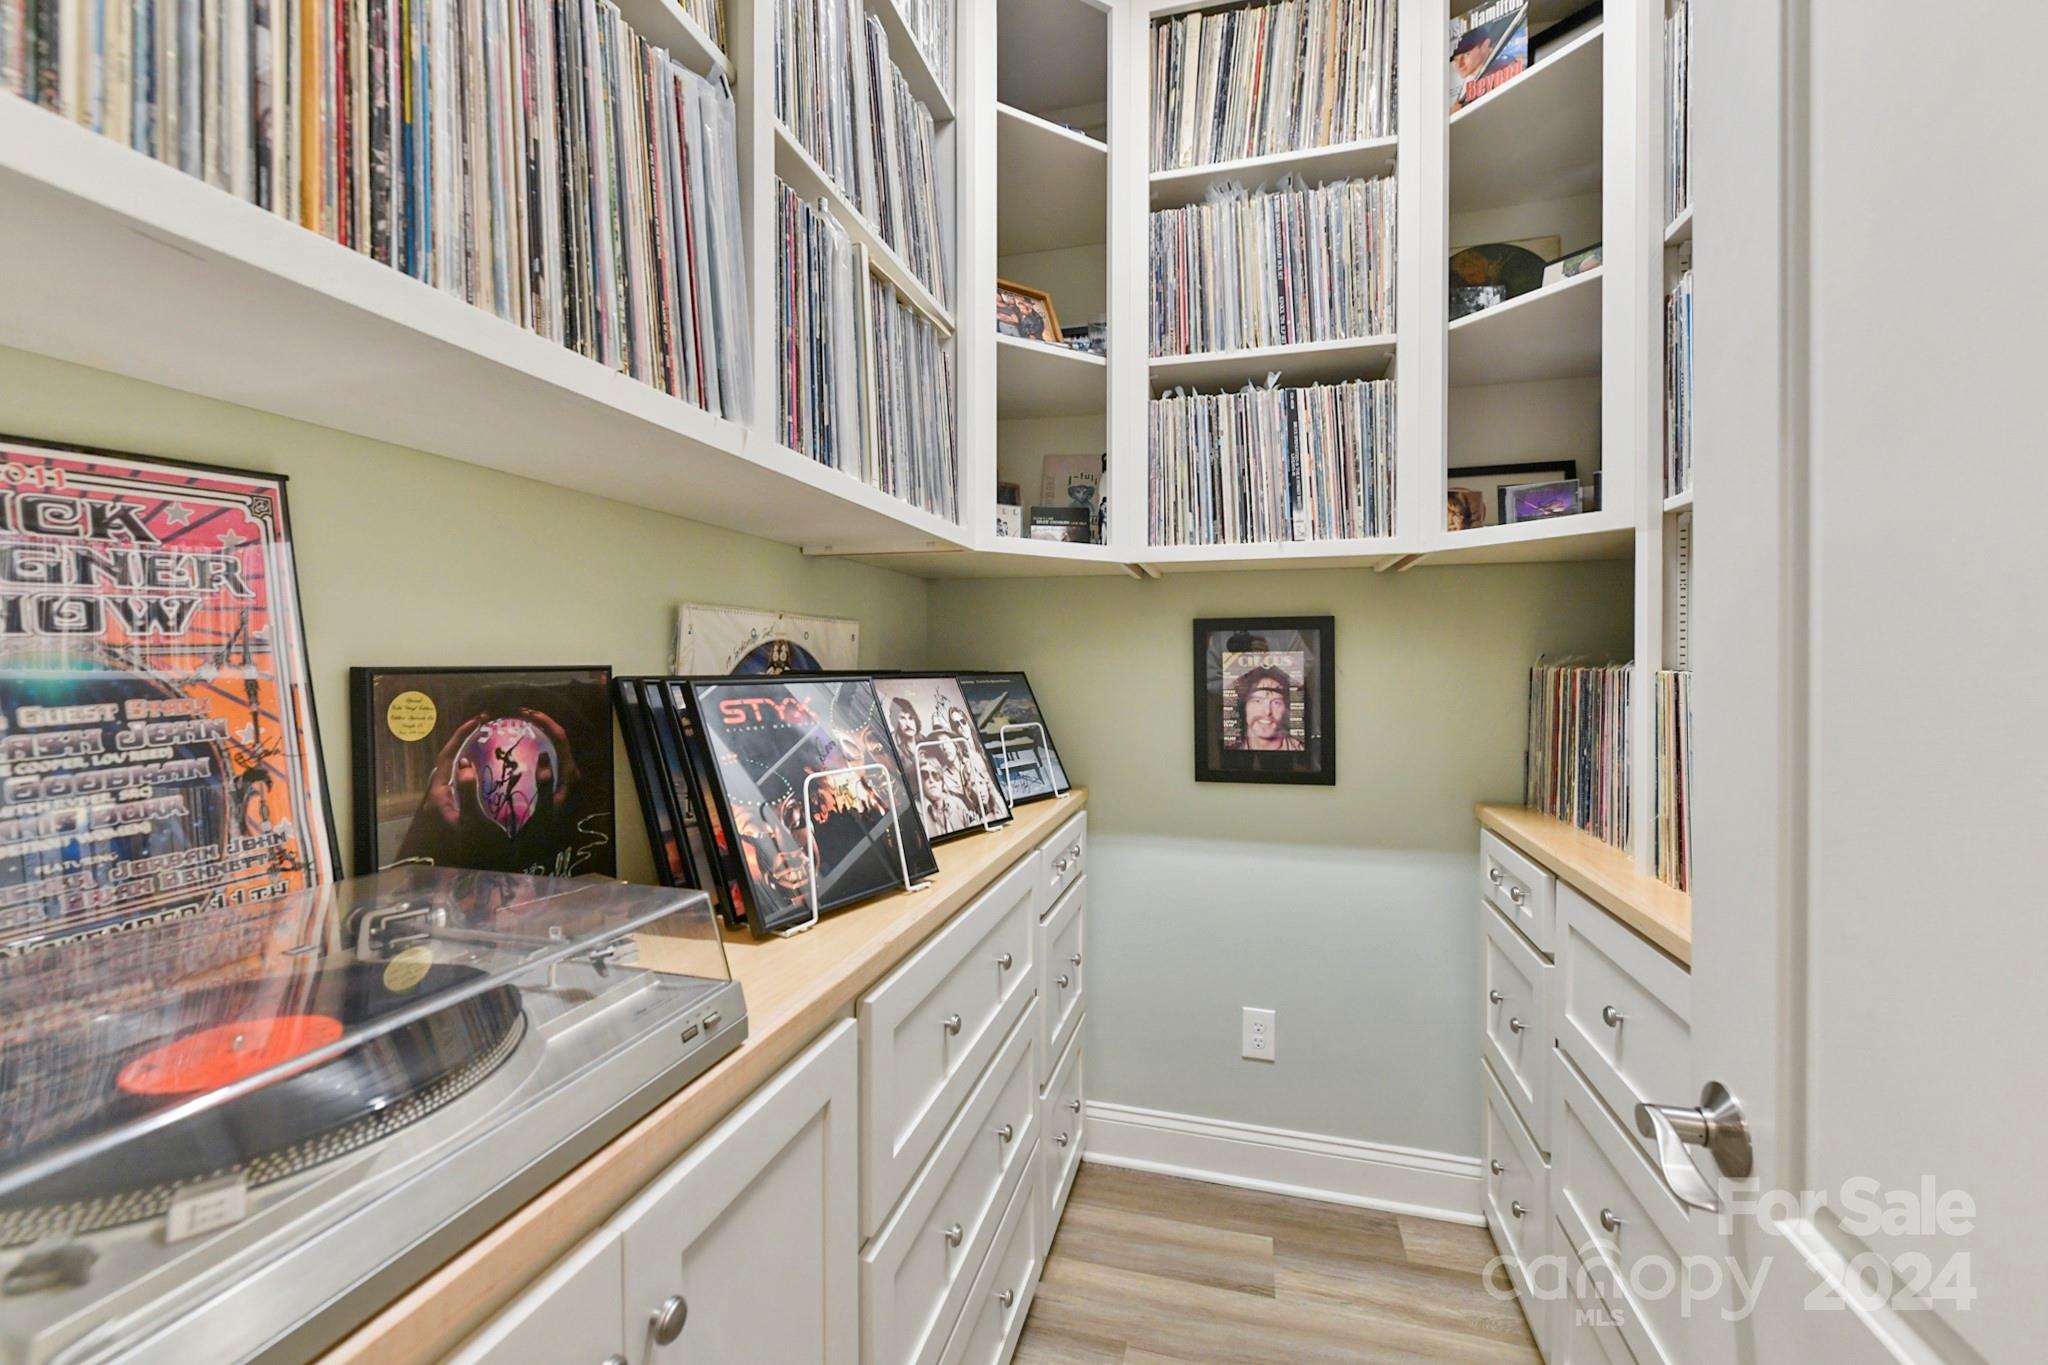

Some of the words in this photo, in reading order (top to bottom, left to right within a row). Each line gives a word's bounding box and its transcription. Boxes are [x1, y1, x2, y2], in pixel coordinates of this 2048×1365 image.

[1471, 0, 1524, 29] Hamilton
[1465, 57, 1524, 102] Beyond
[16, 703, 119, 729] GUEST
[125, 698, 212, 721] STARS
[719, 696, 819, 725] STYX
[115, 718, 231, 751] JOHN
[35, 851, 119, 875] FEATURING
[109, 844, 220, 882] JORDAN
[227, 830, 287, 854] JOHN
[160, 854, 270, 890] BENNETT
